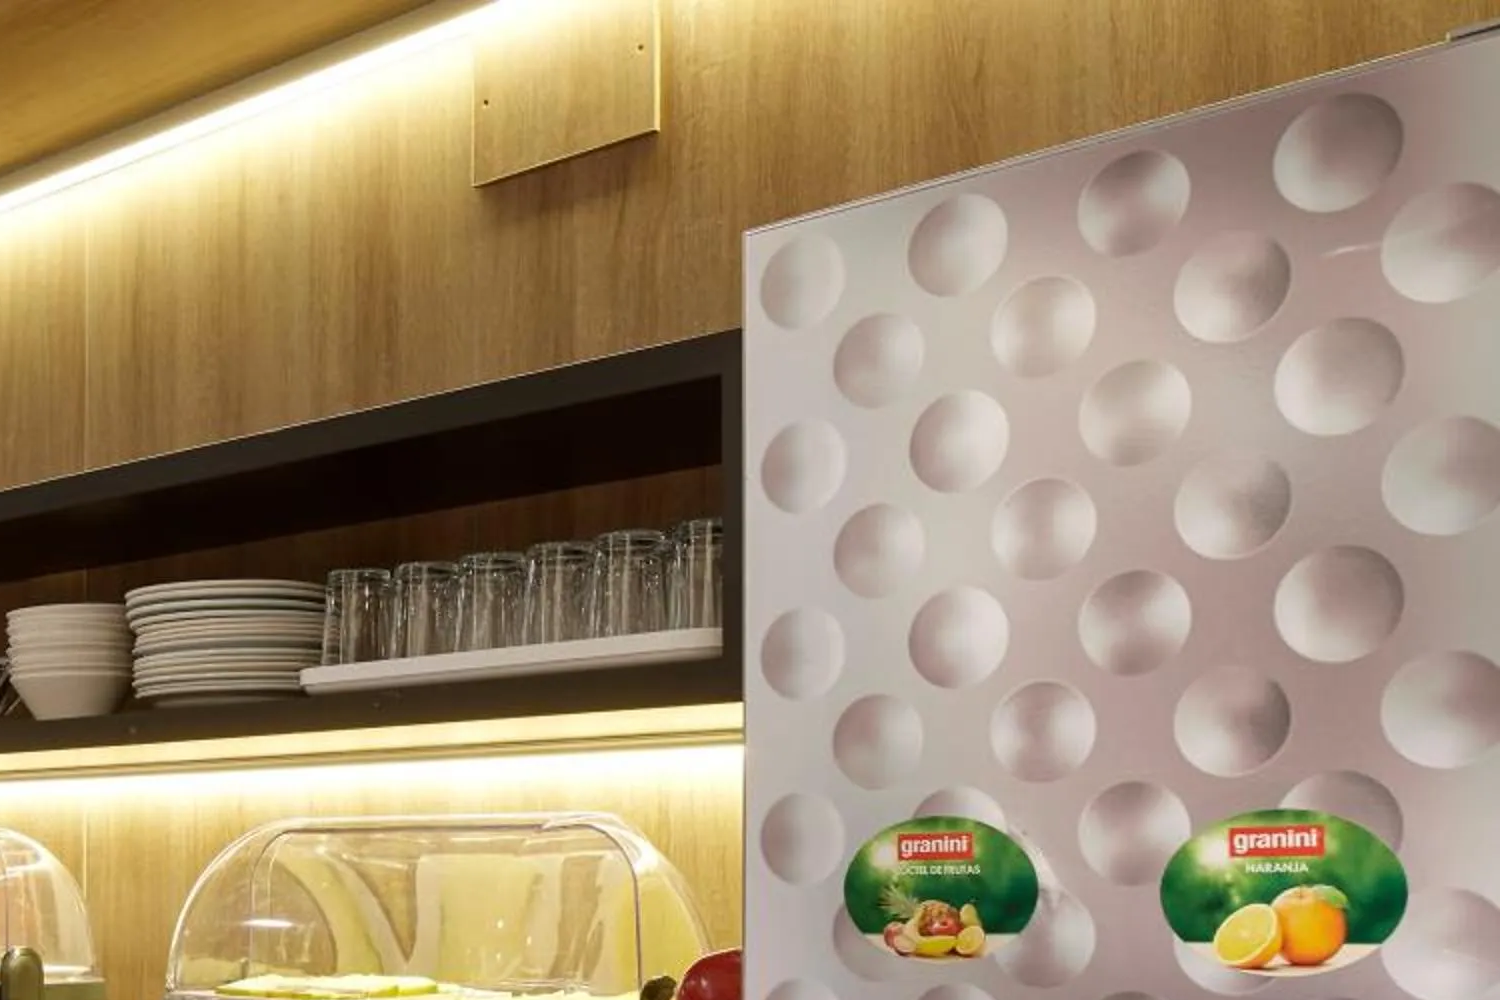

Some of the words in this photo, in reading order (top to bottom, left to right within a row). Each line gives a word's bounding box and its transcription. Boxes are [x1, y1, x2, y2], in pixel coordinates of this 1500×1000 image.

[901, 835, 969, 858] granini
[1234, 828, 1318, 854] granini
[1245, 860, 1309, 873] NARANJA
